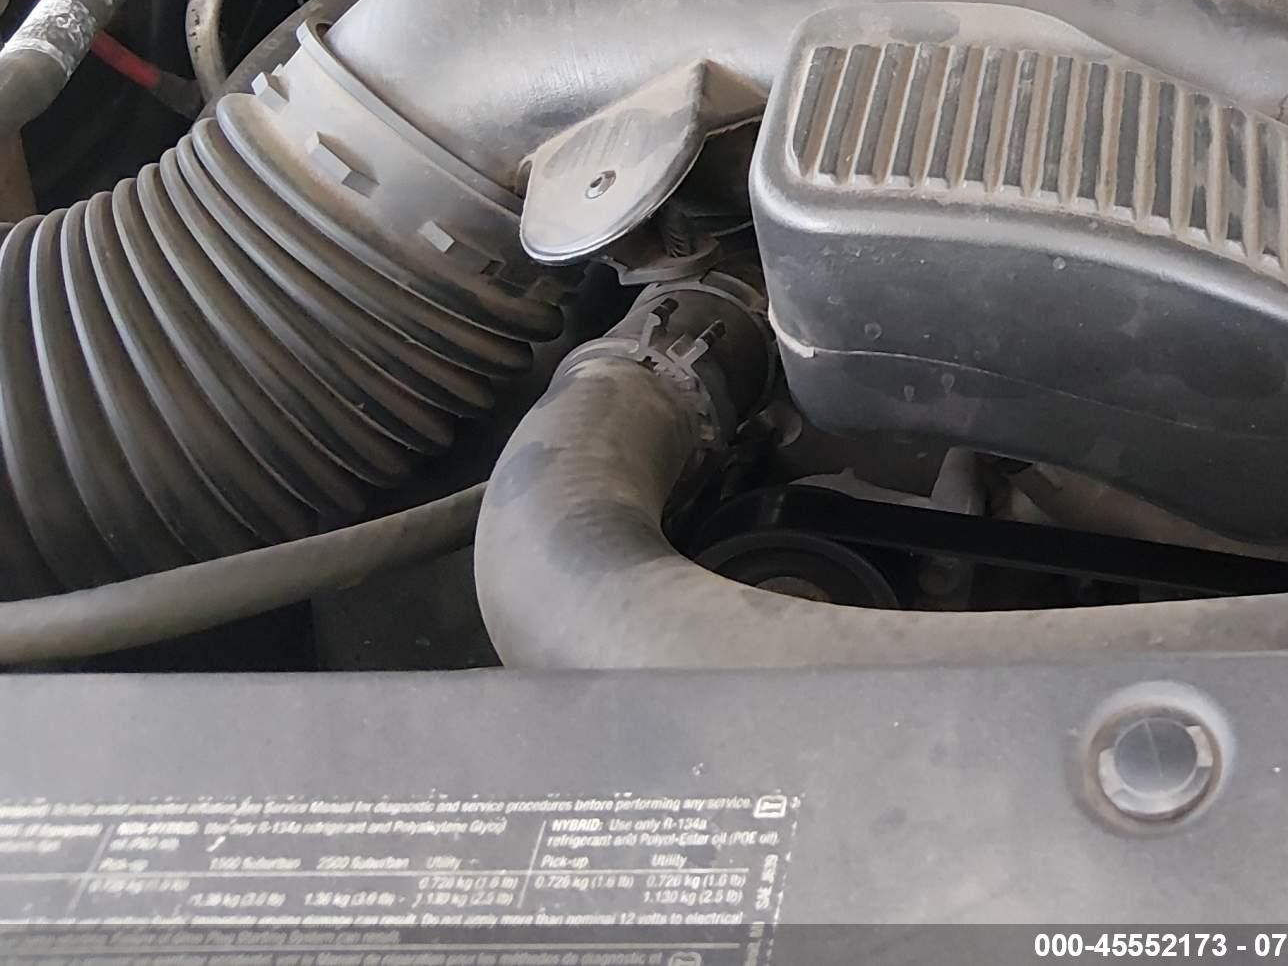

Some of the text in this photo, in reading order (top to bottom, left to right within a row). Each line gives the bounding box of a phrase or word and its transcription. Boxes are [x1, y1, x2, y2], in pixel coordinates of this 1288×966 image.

[505, 800, 573, 814] procedures
[574, 799, 613, 811] before
[614, 798, 680, 813] performing
[682, 799, 706, 811] any
[552, 818, 604, 831] HYBRID:
[609, 819, 633, 832] Use
[634, 818, 661, 832] only
[541, 855, 590, 869] Pick-up
[651, 854, 688, 868] Utility
[684, 874, 701, 890] kg
